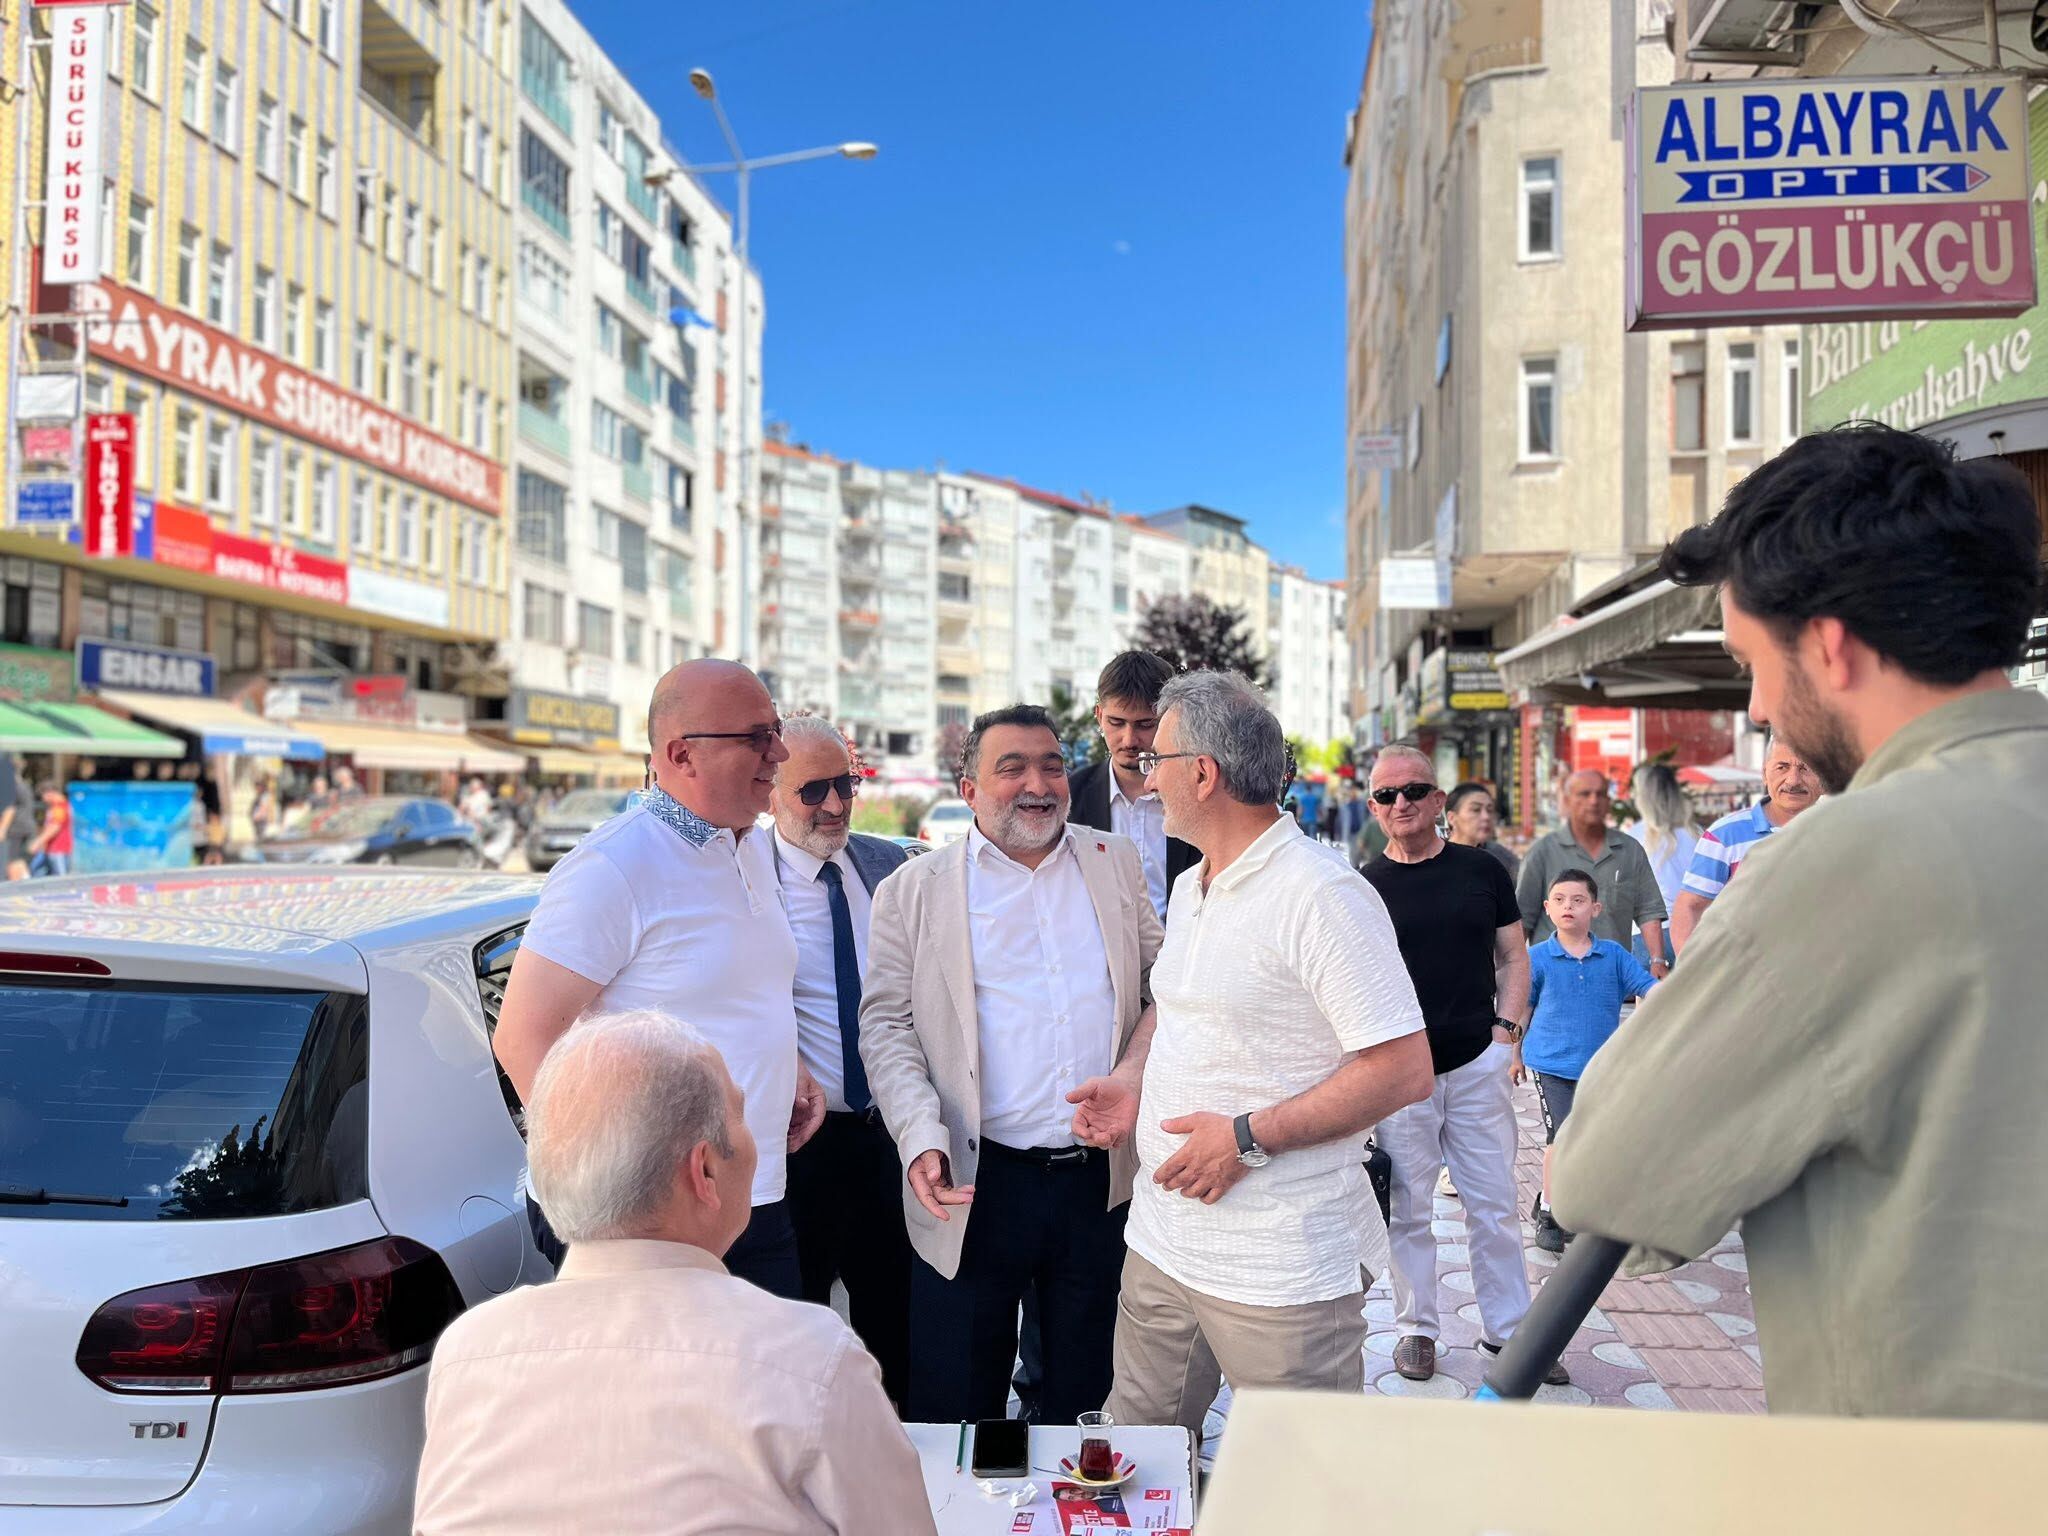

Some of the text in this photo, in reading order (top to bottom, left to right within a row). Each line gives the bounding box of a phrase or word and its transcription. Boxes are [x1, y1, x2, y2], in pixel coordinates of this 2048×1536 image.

[1655, 87, 2009, 163] ALBAYRAK
[62, 160, 83, 269] KURSU
[1656, 205, 2014, 296] GÖZLÜKÇÜ
[76, 283, 267, 411] BAYRAK
[101, 647, 204, 692] ENSAR
[129, 1420, 187, 1439] TDI
